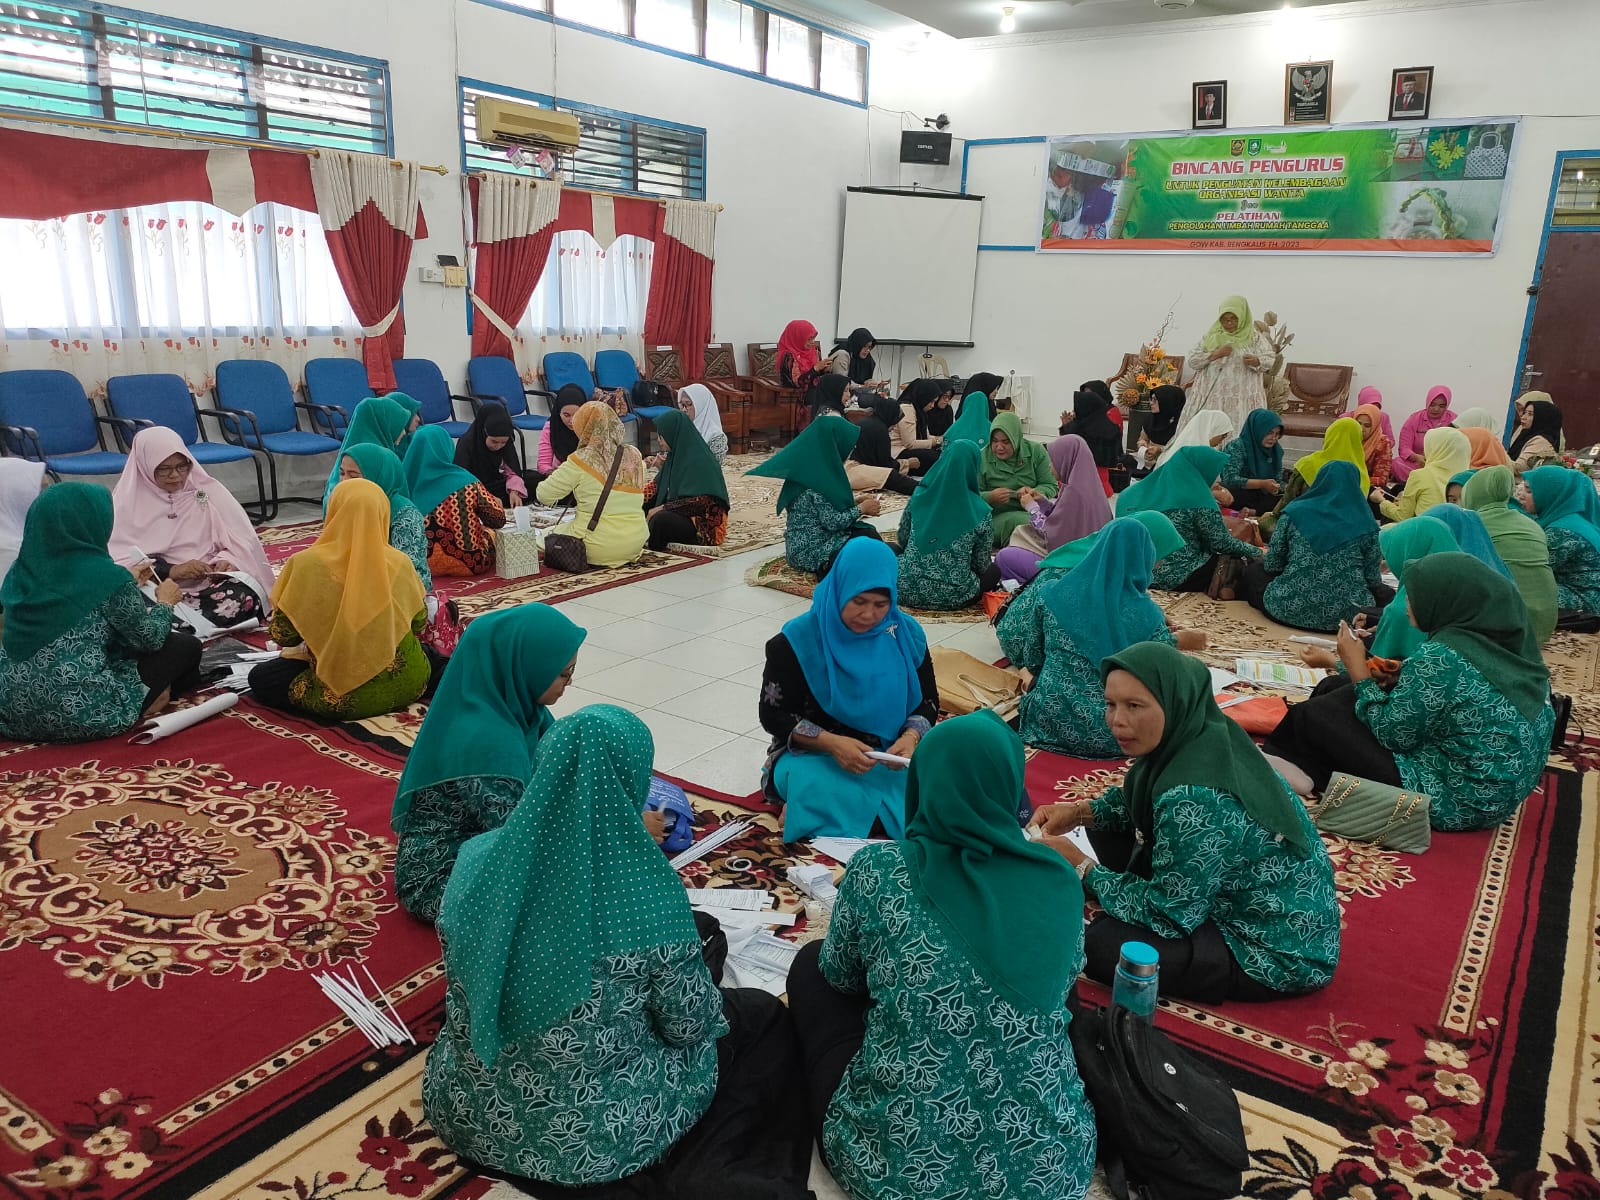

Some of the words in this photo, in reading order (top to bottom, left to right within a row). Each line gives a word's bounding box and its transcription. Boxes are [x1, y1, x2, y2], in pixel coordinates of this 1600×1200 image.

[1171, 160, 1244, 175] BINCANG
[1249, 158, 1344, 173] PENGURUS
[1166, 180, 1199, 190] UNTUK
[1202, 179, 1262, 188] PENGUATAN
[1264, 177, 1346, 188] KELEMBAGAAN
[1200, 189, 1262, 198] ORGANISASI
[1264, 188, 1306, 198] WANITA
[1216, 212, 1280, 220] PELATIHAN
[1168, 222, 1222, 230] PENGOLAHAN
[1222, 222, 1252, 230] LIMBAH
[1254, 222, 1284, 230] RUMAH
